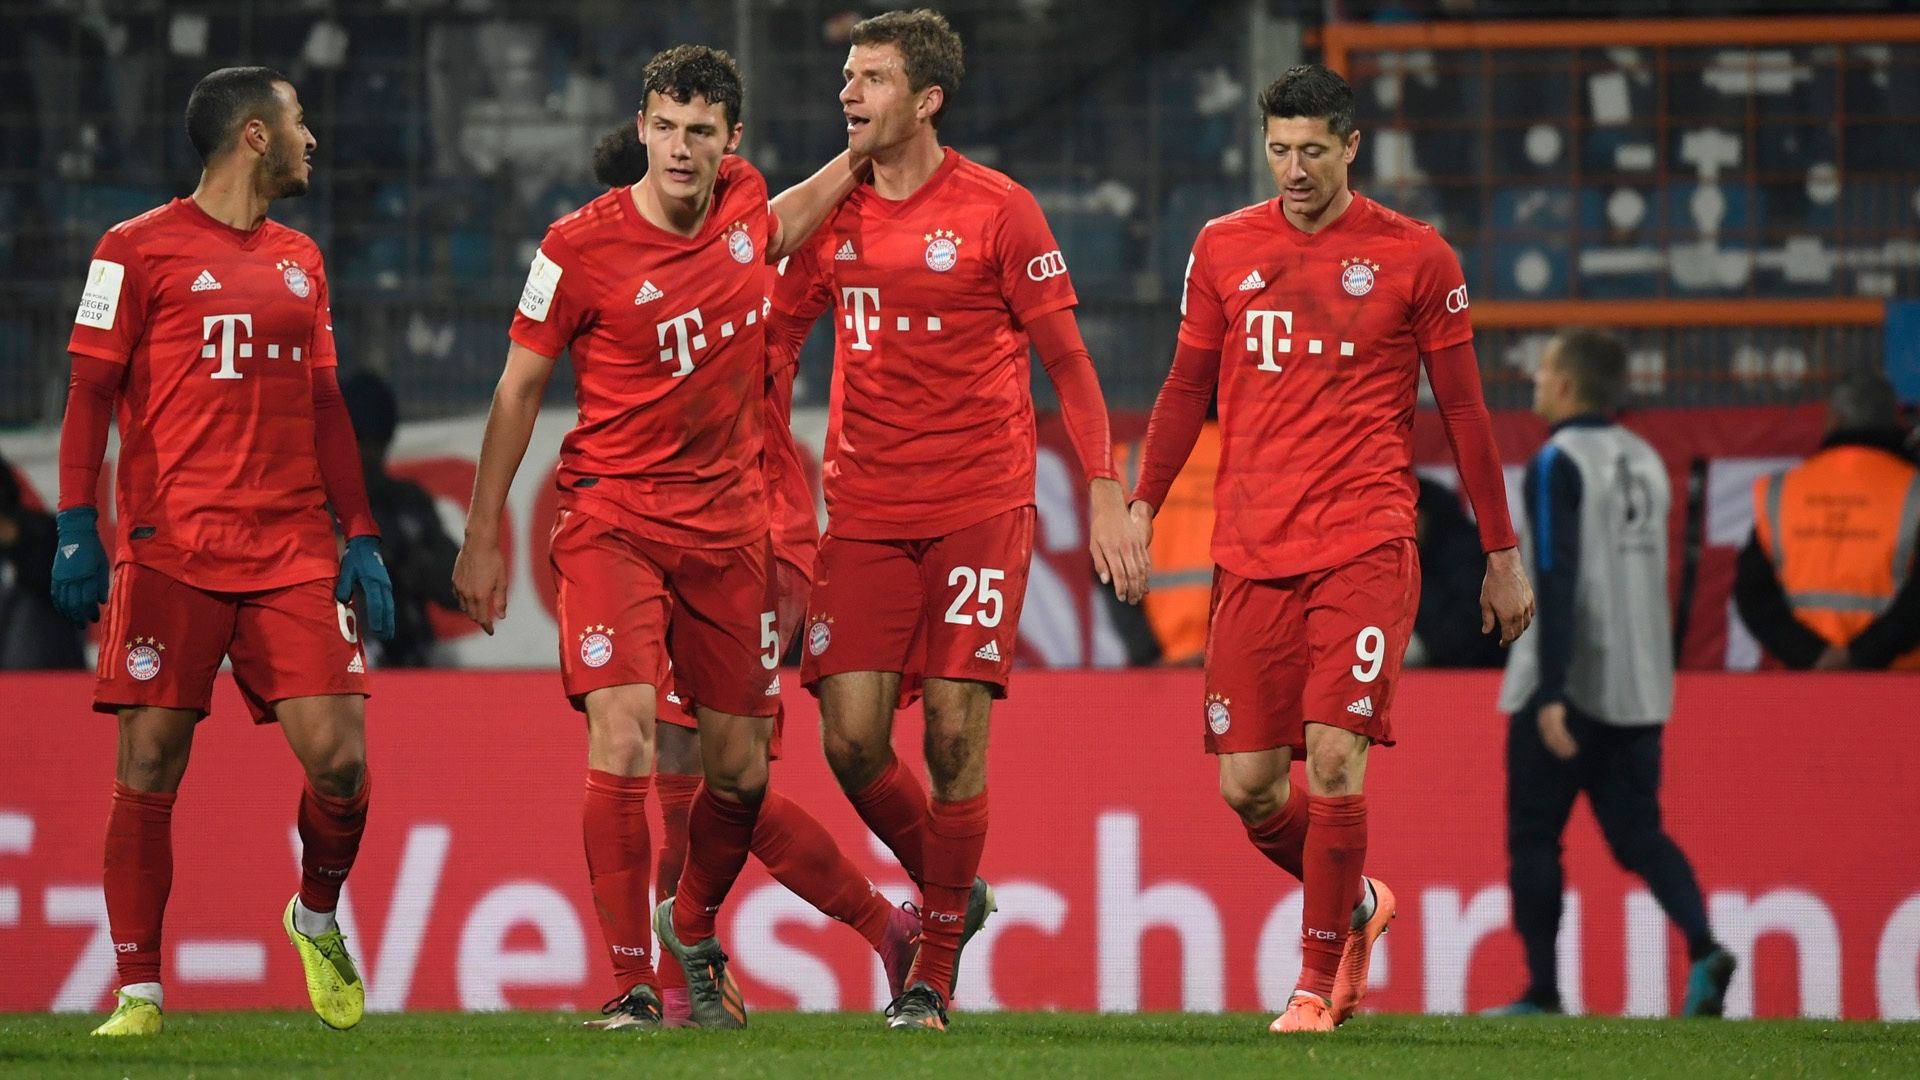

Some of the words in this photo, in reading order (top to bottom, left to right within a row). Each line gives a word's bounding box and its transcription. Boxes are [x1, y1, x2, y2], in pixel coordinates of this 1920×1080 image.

[190, 281, 222, 292] adidas
[1238, 280, 1266, 291] adidas
[634, 289, 664, 306] adidas
[80, 310, 103, 321] 2019
[944, 565, 1005, 628] 25
[336, 600, 358, 644] 6
[760, 611, 780, 670] 5
[974, 649, 1001, 662] adidas
[1352, 626, 1385, 682] 9
[928, 911, 958, 923] FCB
[1308, 927, 1337, 940] FCB
[113, 942, 138, 953] FCB
[612, 944, 645, 956] FCB
